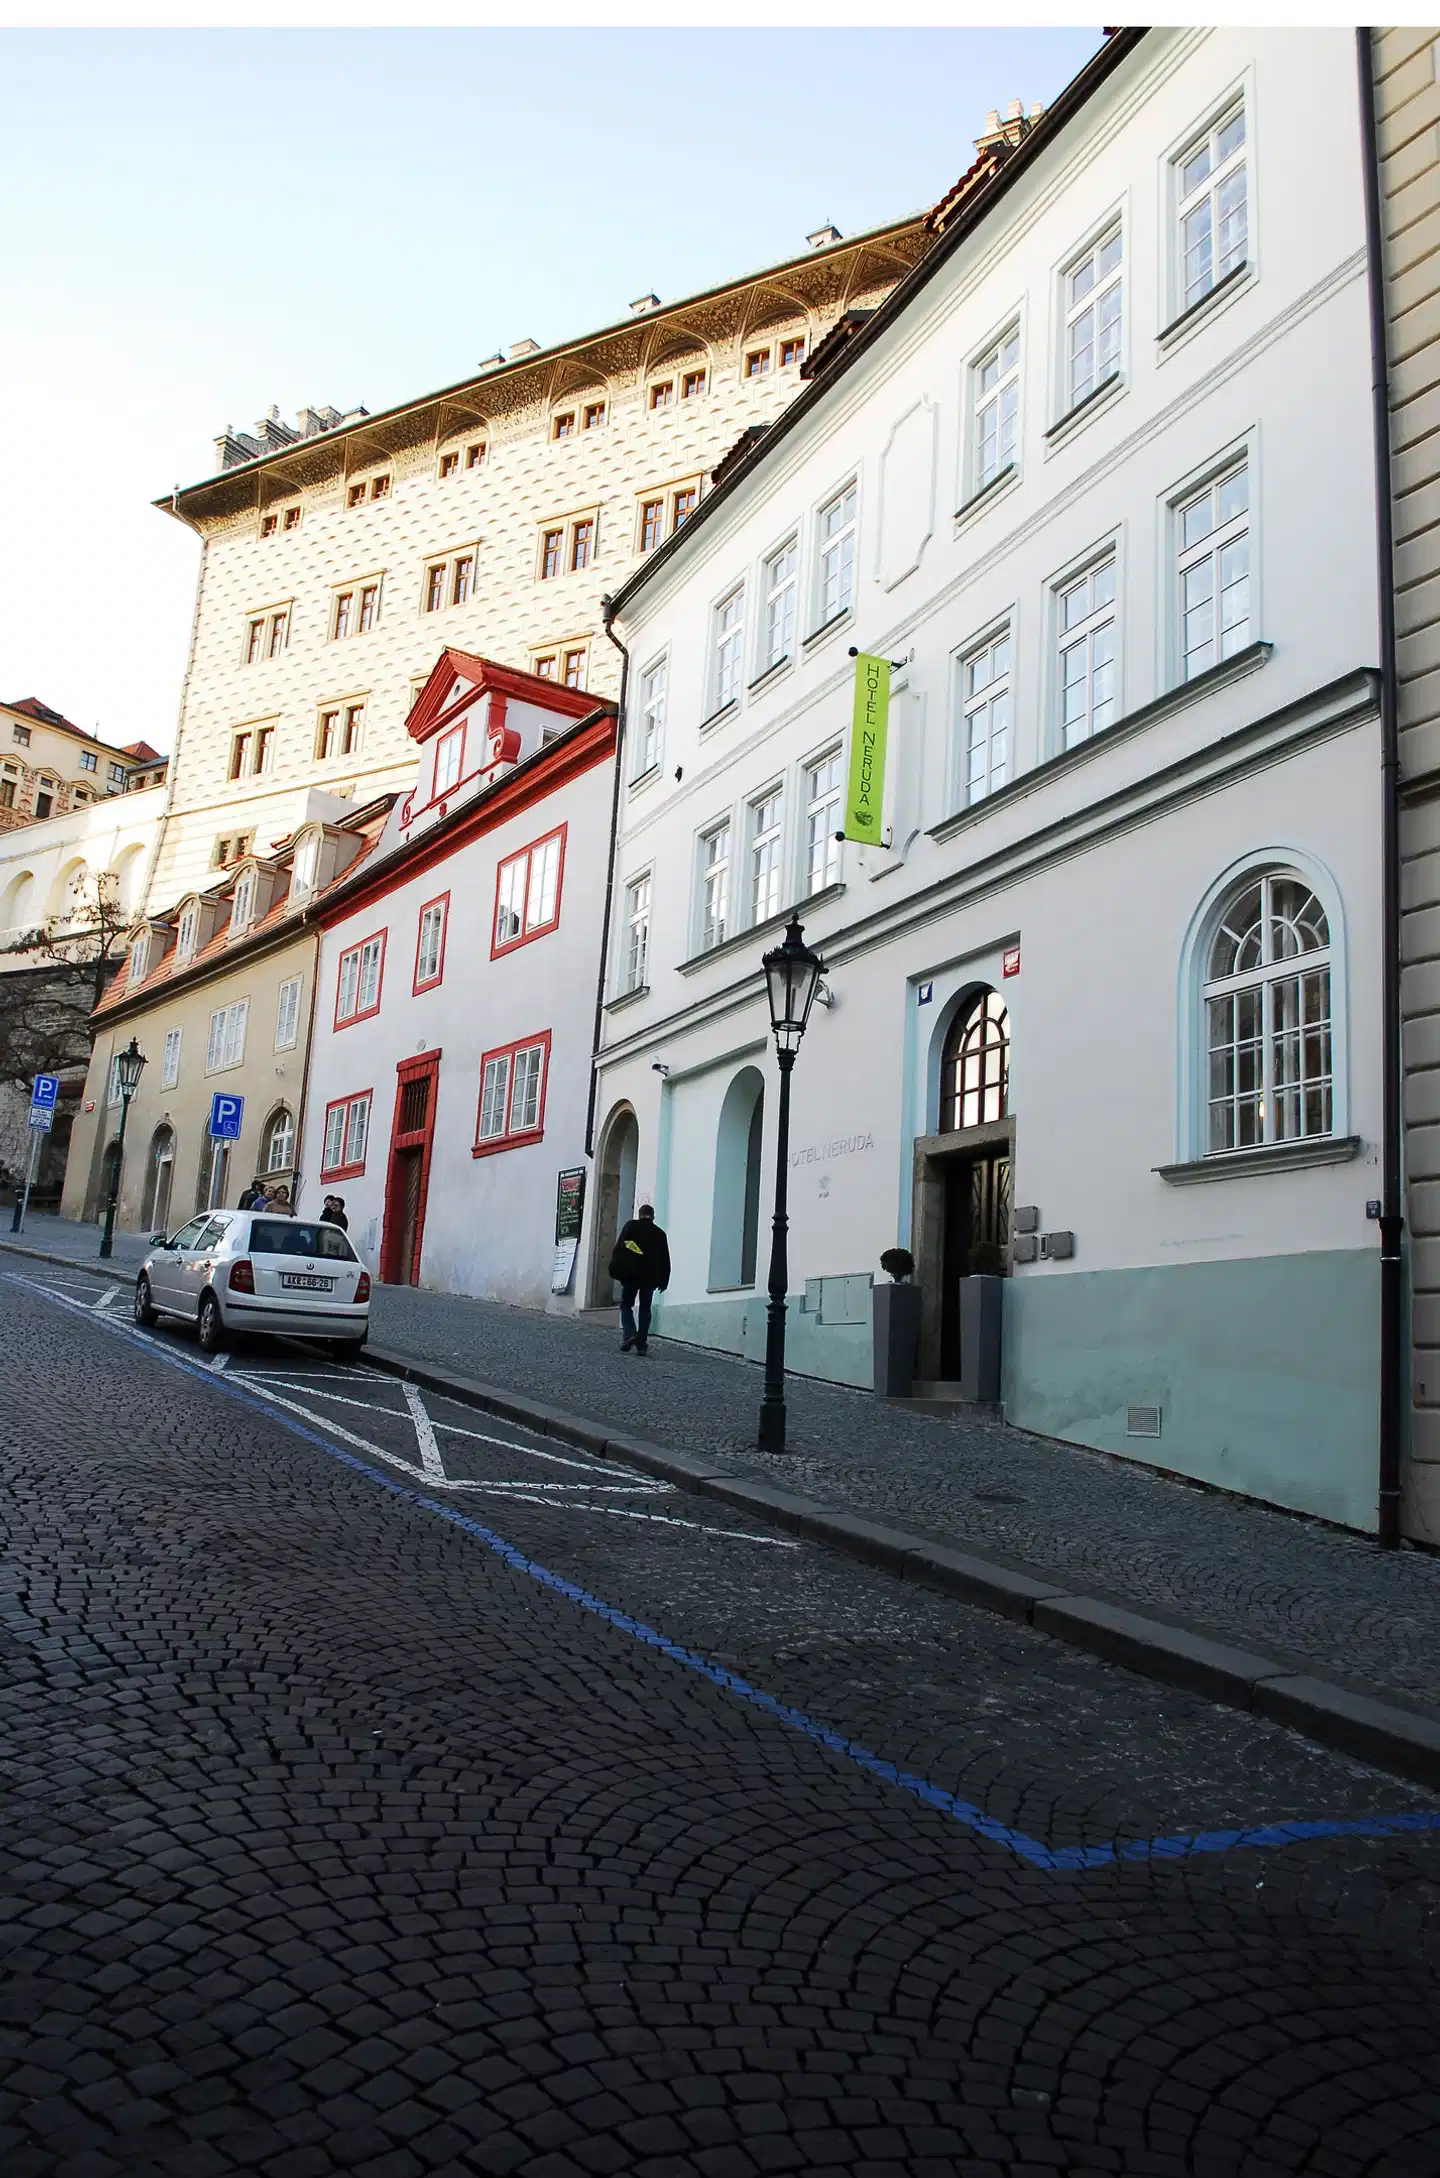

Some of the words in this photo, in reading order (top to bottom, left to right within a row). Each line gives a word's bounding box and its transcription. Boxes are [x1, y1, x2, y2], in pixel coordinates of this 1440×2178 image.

[867, 664, 879, 724] HOTEL
[859, 731, 875, 805] NERUDA
[38, 1079, 52, 1097] P
[217, 1099, 237, 1124] P
[822, 1132, 875, 1160] NERUDA
